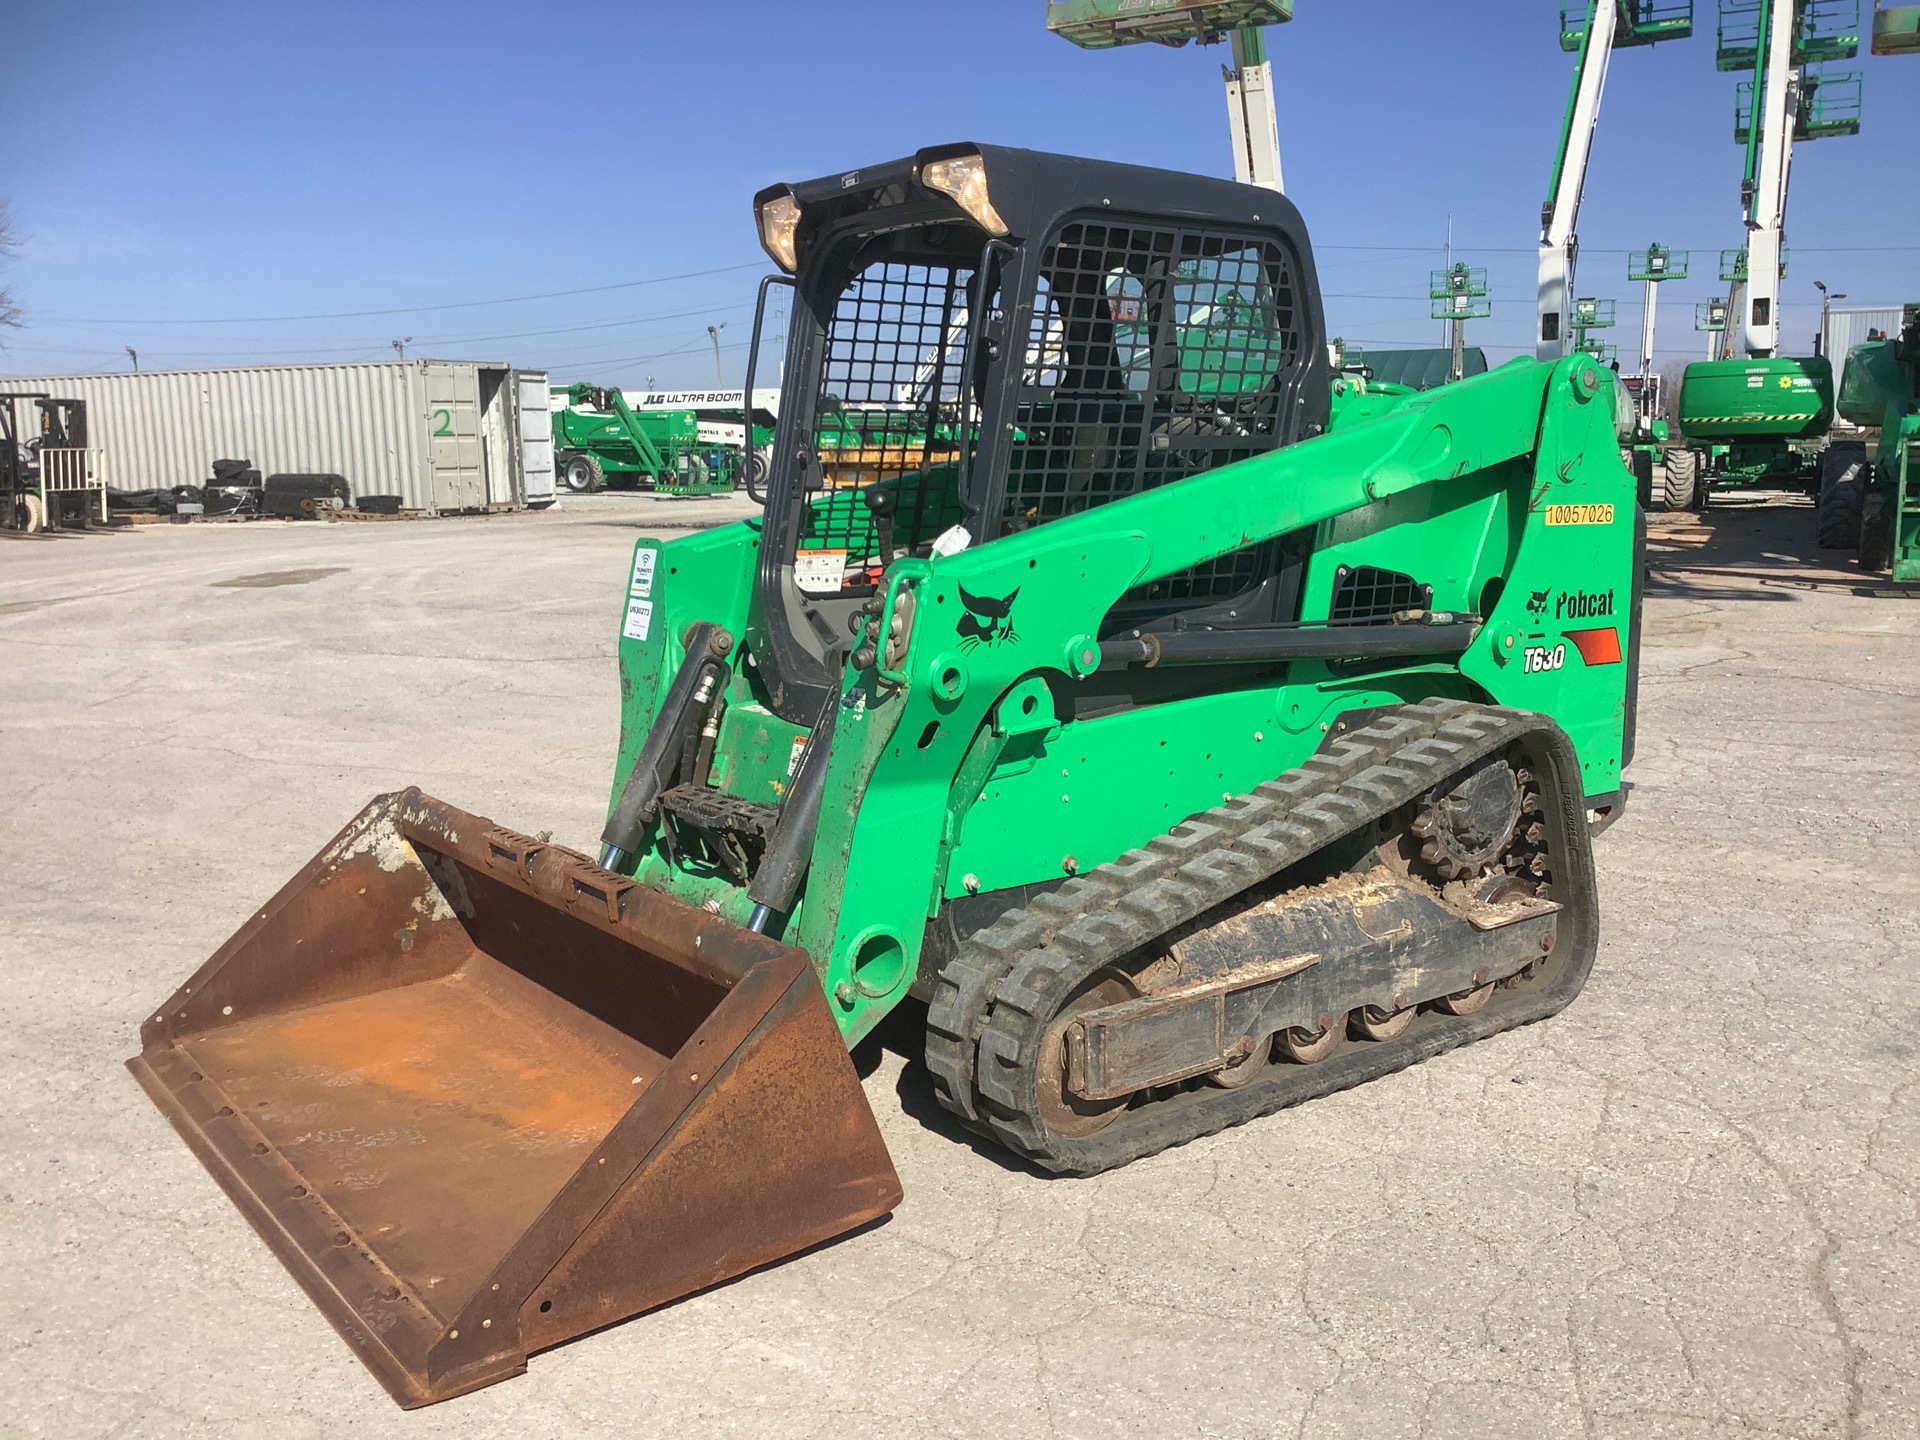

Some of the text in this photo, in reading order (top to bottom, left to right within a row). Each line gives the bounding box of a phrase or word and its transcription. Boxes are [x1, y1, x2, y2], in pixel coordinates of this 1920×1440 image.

[643, 392, 742, 405] JLG ULTRA BOOM
[433, 409, 454, 435] 2
[1548, 504, 1613, 524] 10057026
[1523, 642, 1566, 675] T630
